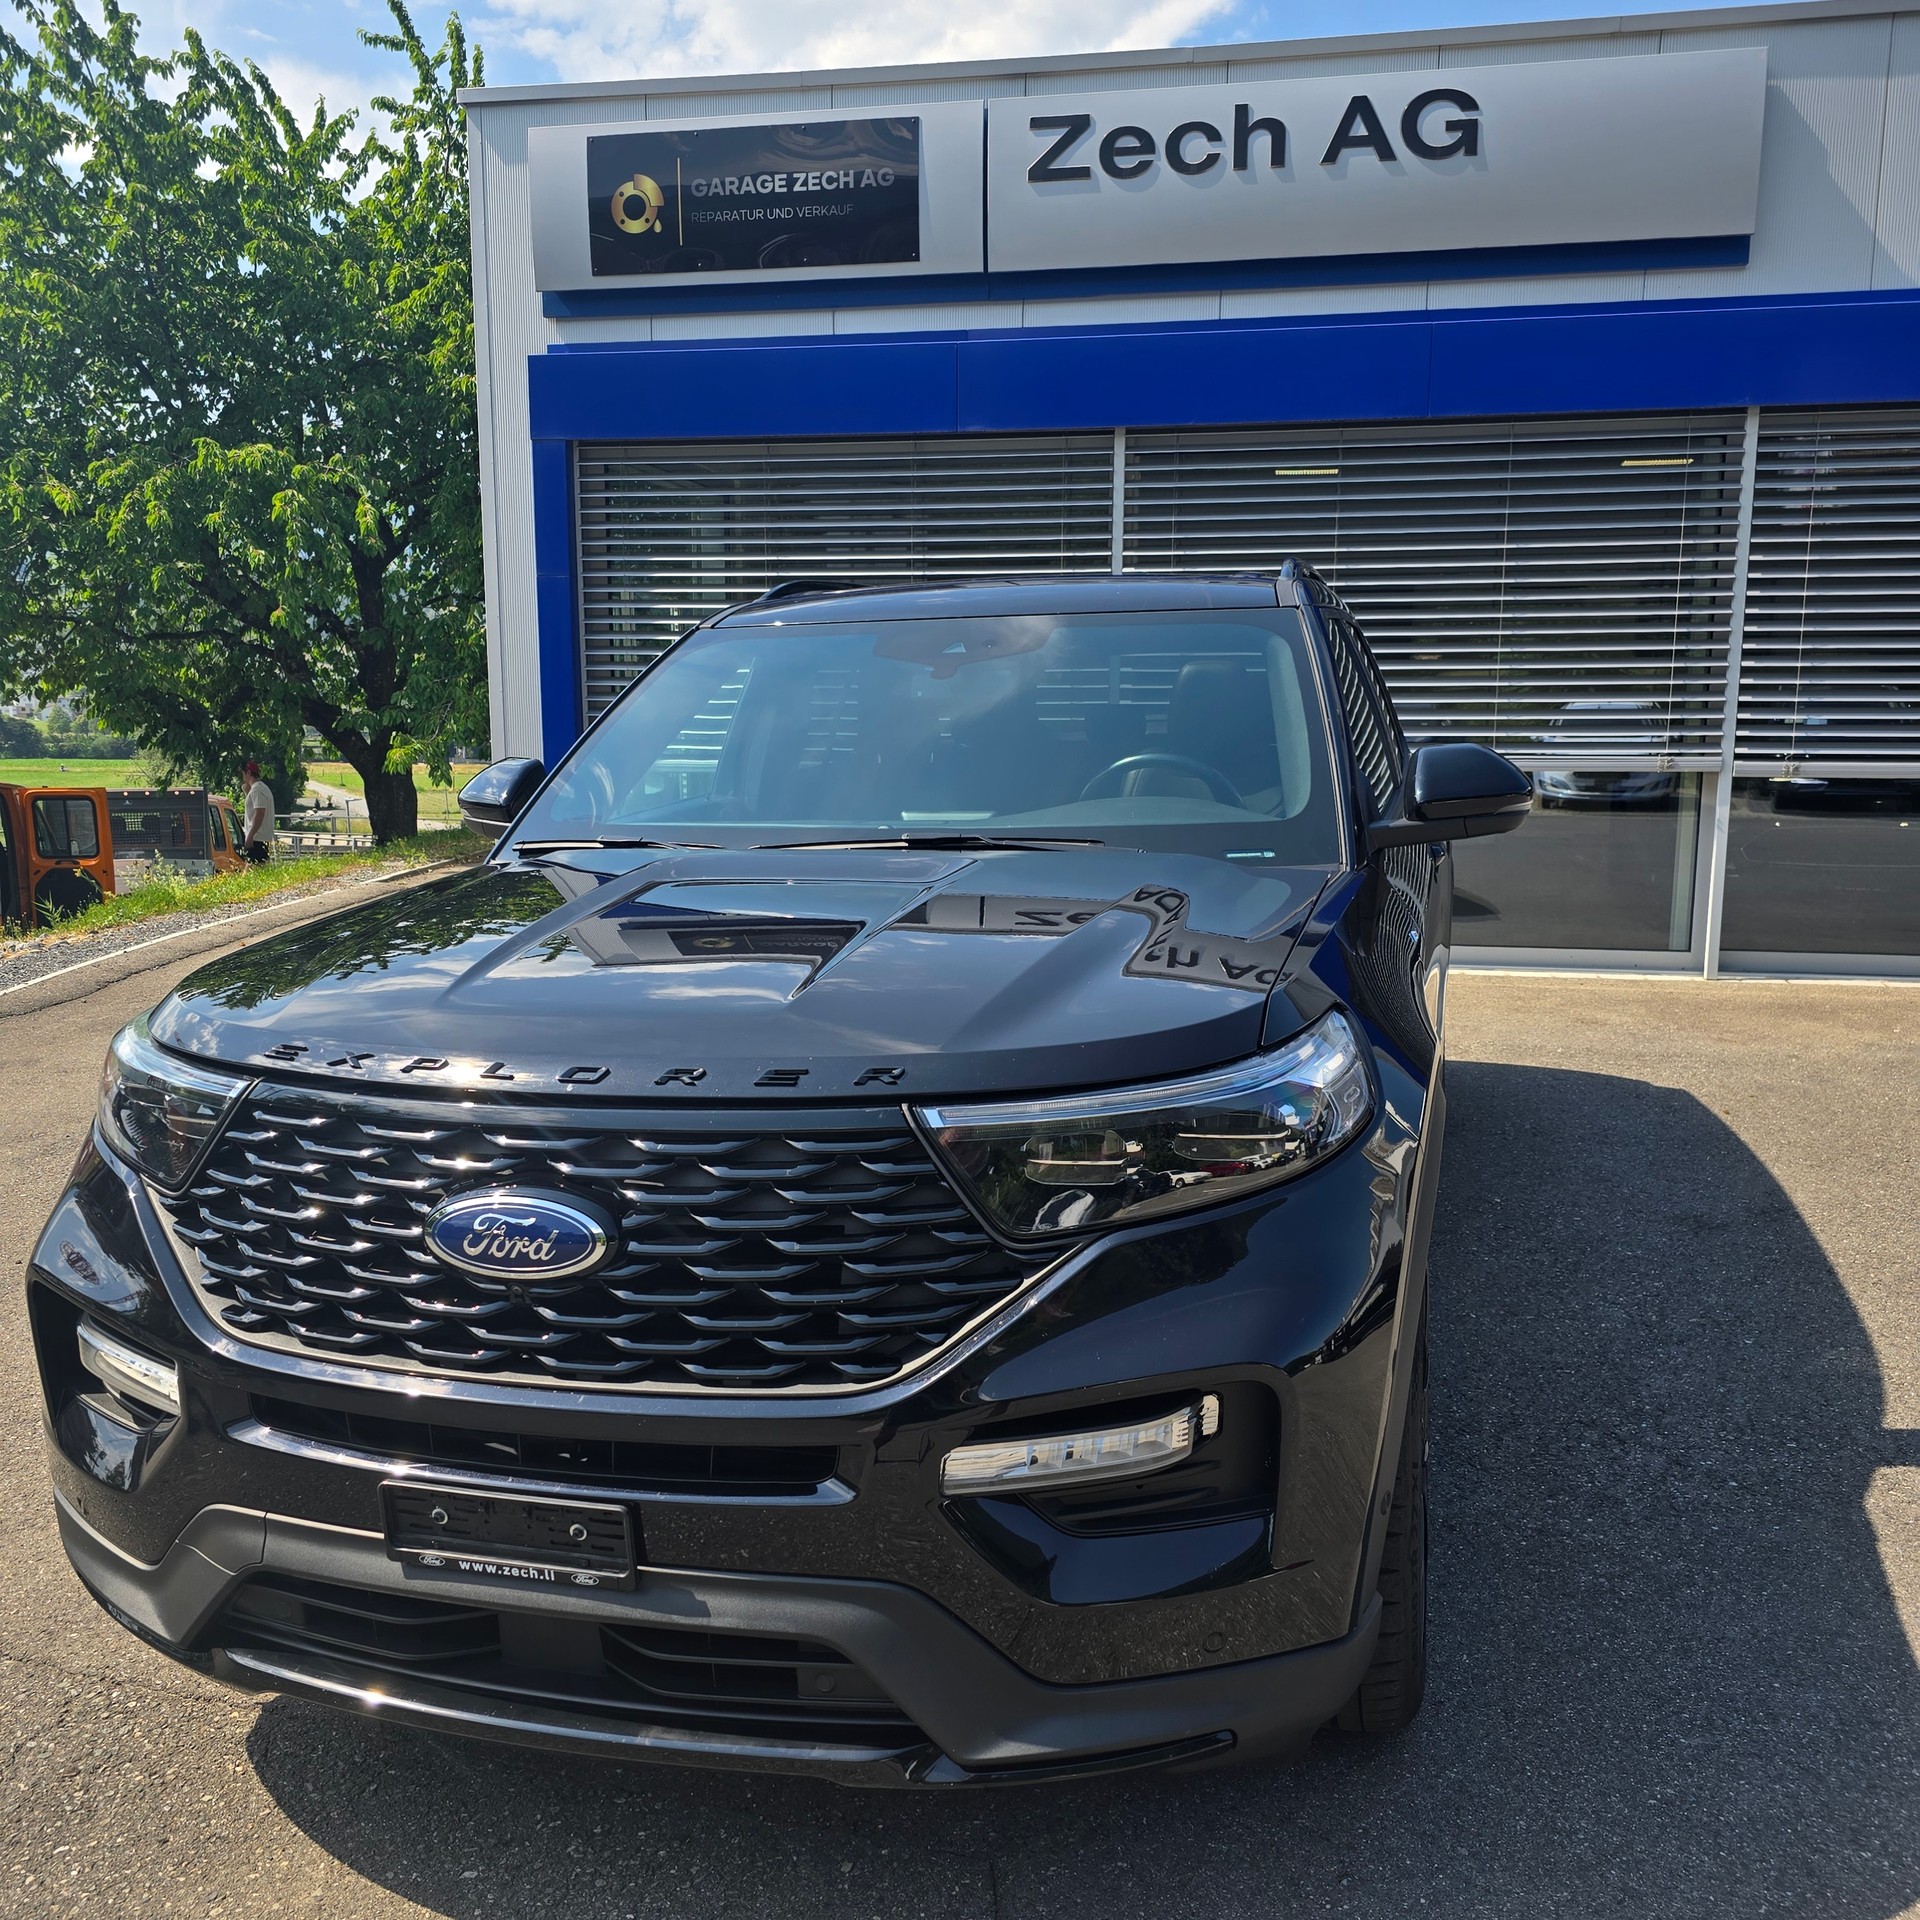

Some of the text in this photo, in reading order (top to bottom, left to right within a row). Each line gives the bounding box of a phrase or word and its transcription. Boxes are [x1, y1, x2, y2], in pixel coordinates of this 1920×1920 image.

[1027, 87, 1480, 183] Zech AG
[691, 166, 895, 197] GARAGE ZECH AG
[691, 203, 854, 223] REPARATUR UND VERKAUF
[262, 1043, 907, 1087] EXPLORER
[462, 1212, 560, 1261] Ford
[421, 1555, 444, 1566] Ford
[458, 1560, 555, 1581] www.zech.li
[573, 1573, 597, 1585] Ford
